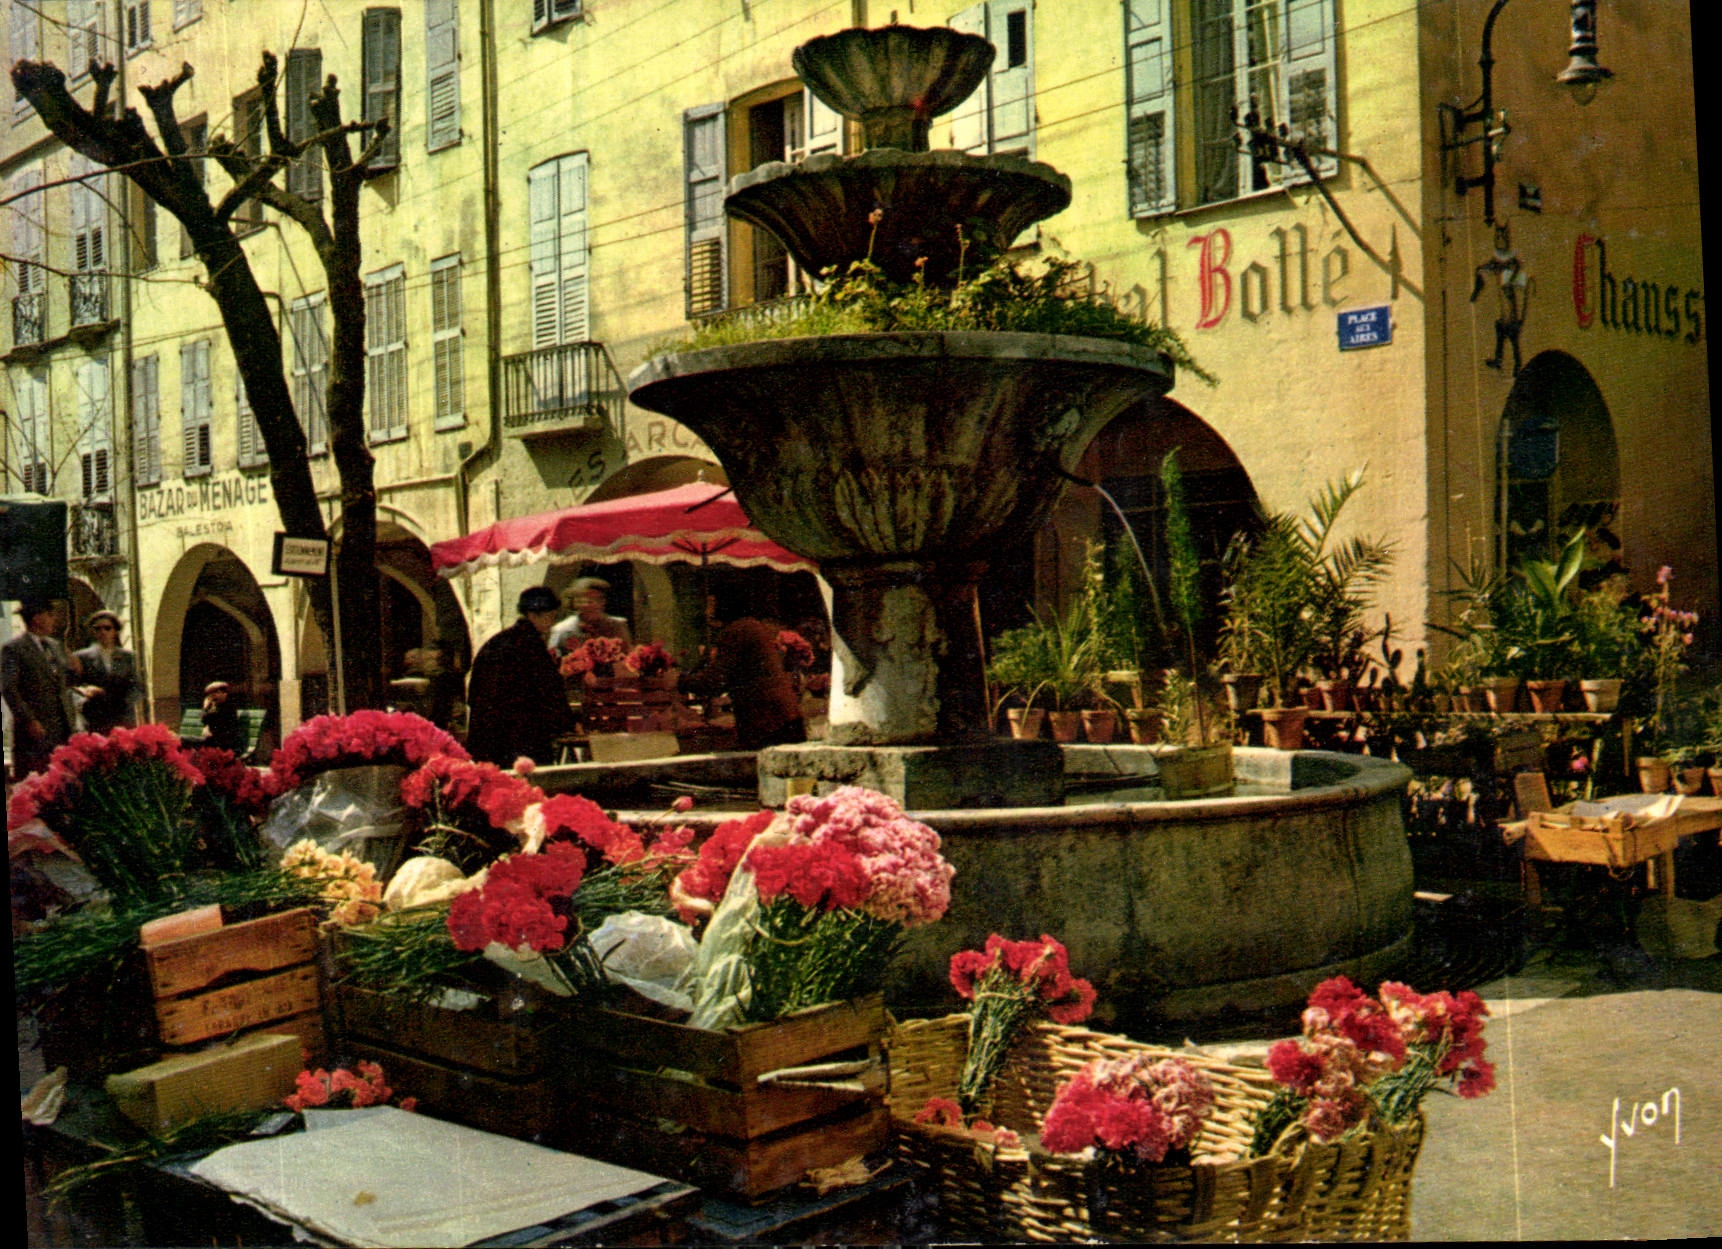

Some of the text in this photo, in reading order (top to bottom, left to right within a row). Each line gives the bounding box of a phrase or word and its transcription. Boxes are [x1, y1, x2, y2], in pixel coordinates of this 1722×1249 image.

[1187, 222, 1350, 330] Botté
[1348, 312, 1377, 325] PLACE
[1350, 332, 1378, 344] AIRES
[139, 487, 185, 520] BAZAR
